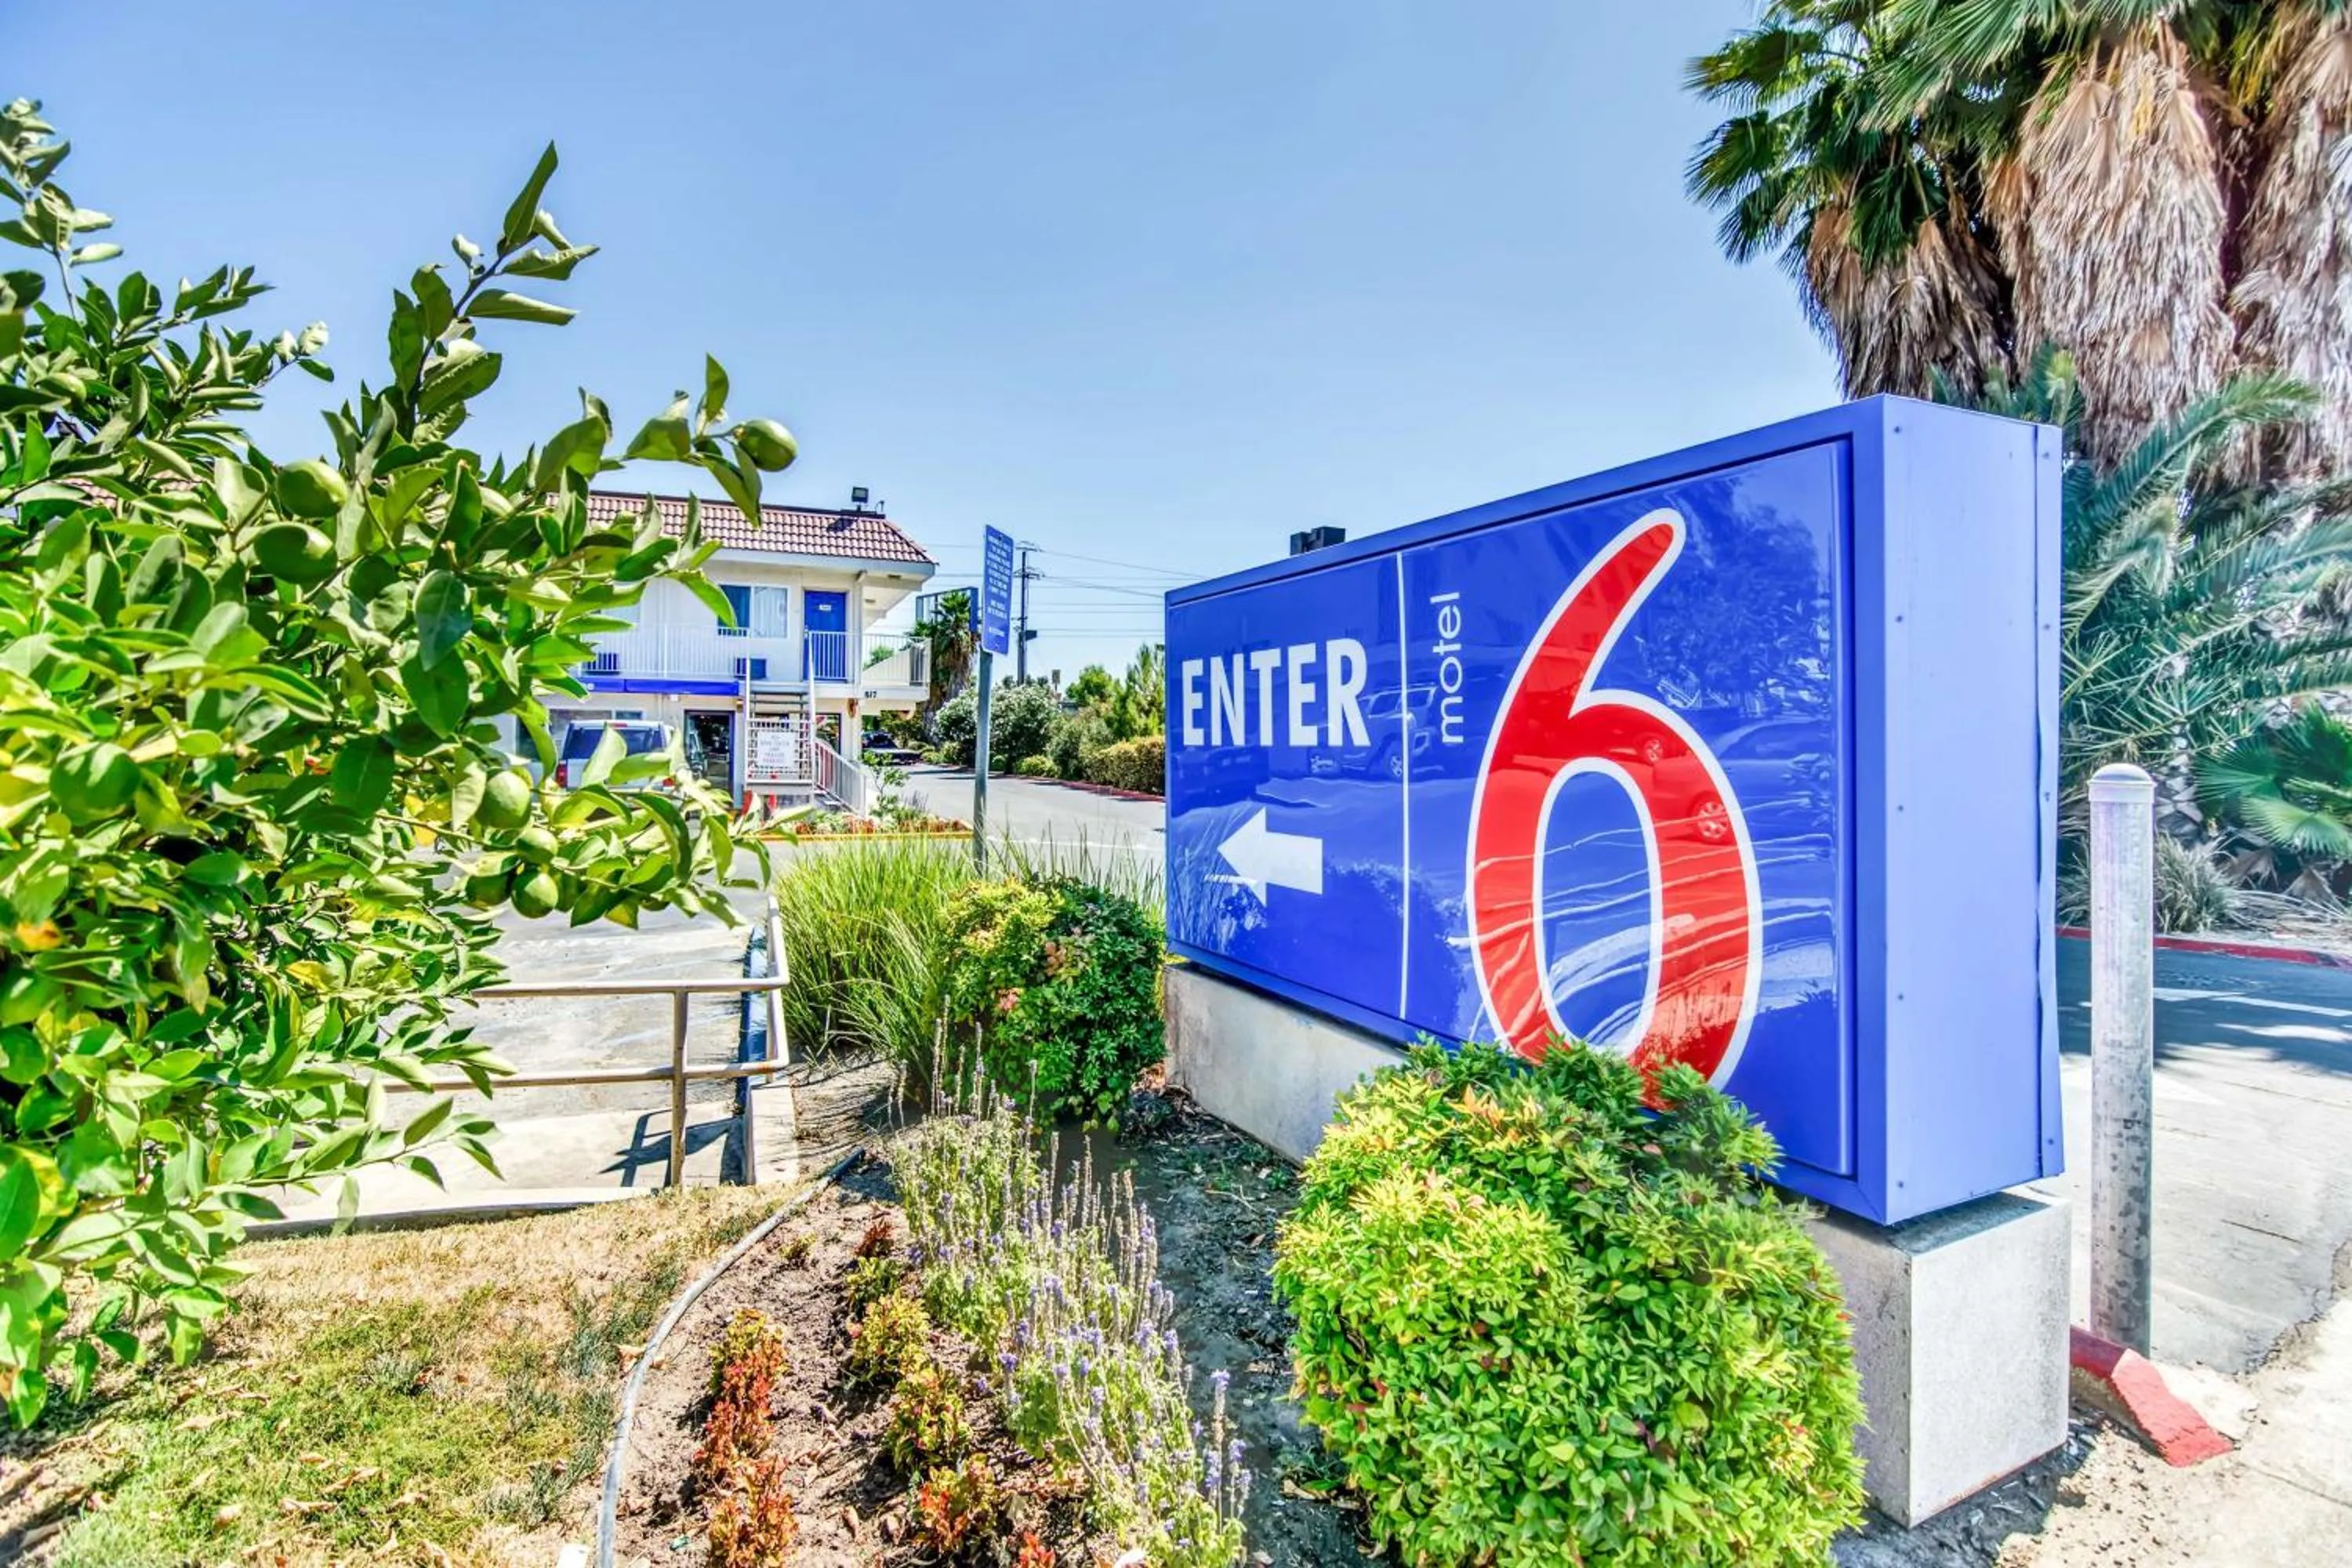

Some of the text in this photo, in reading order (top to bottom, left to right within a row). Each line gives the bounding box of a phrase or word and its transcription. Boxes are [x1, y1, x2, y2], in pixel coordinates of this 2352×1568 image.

[1181, 637, 1370, 747] ENTER
[1430, 592, 1464, 743] motel
[1465, 507, 1763, 1110] 6
